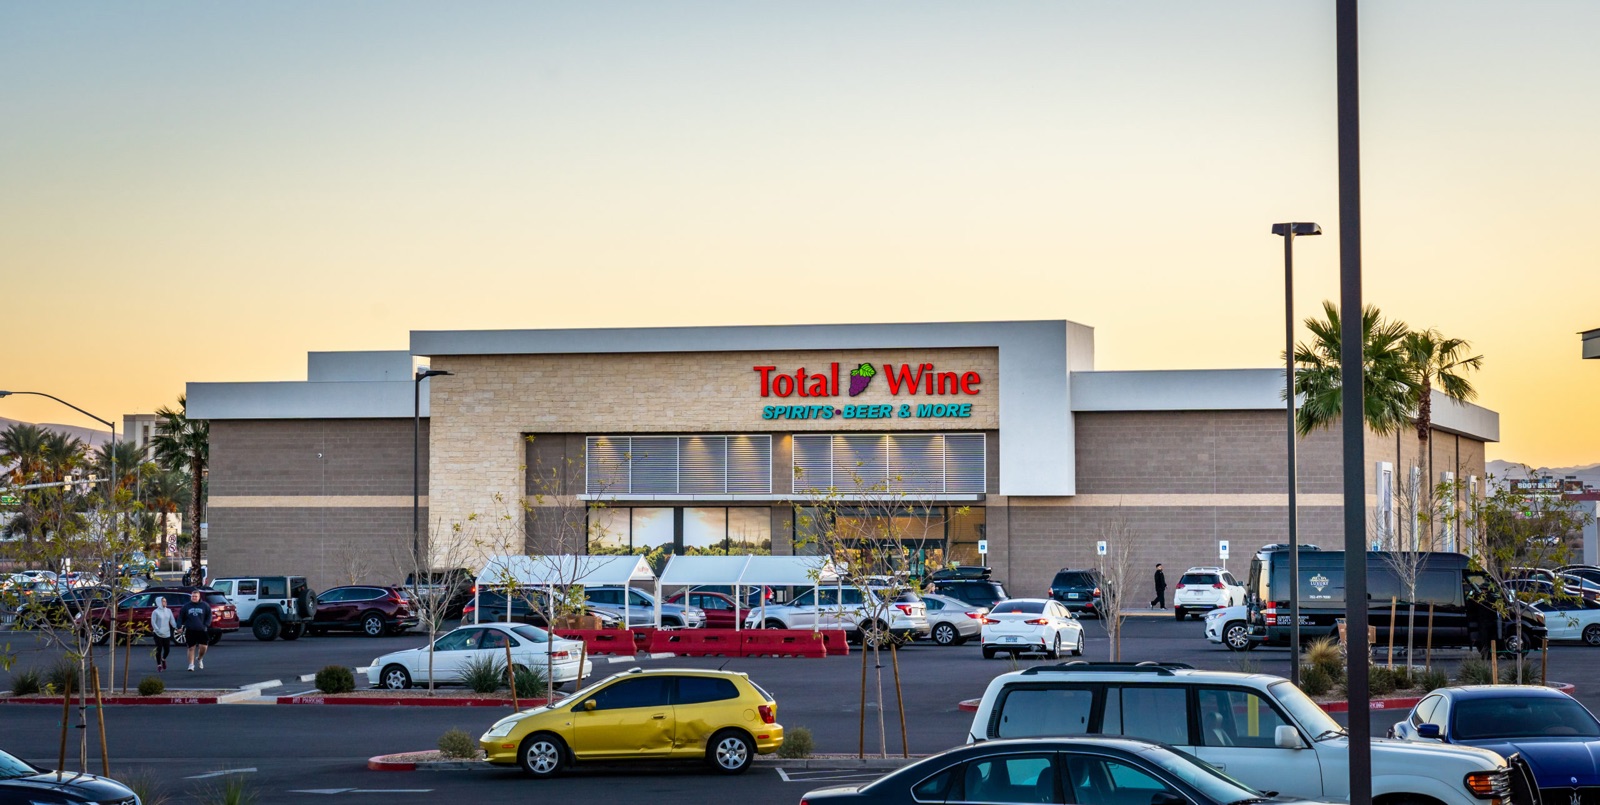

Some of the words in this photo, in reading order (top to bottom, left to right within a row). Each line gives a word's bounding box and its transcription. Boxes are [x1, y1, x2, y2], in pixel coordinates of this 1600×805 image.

[753, 362, 839, 397] Total
[883, 363, 981, 395] Wine
[762, 405, 834, 420] SPIRITS
[842, 404, 892, 419] BEER
[897, 404, 911, 418] &
[916, 403, 972, 418] MORE
